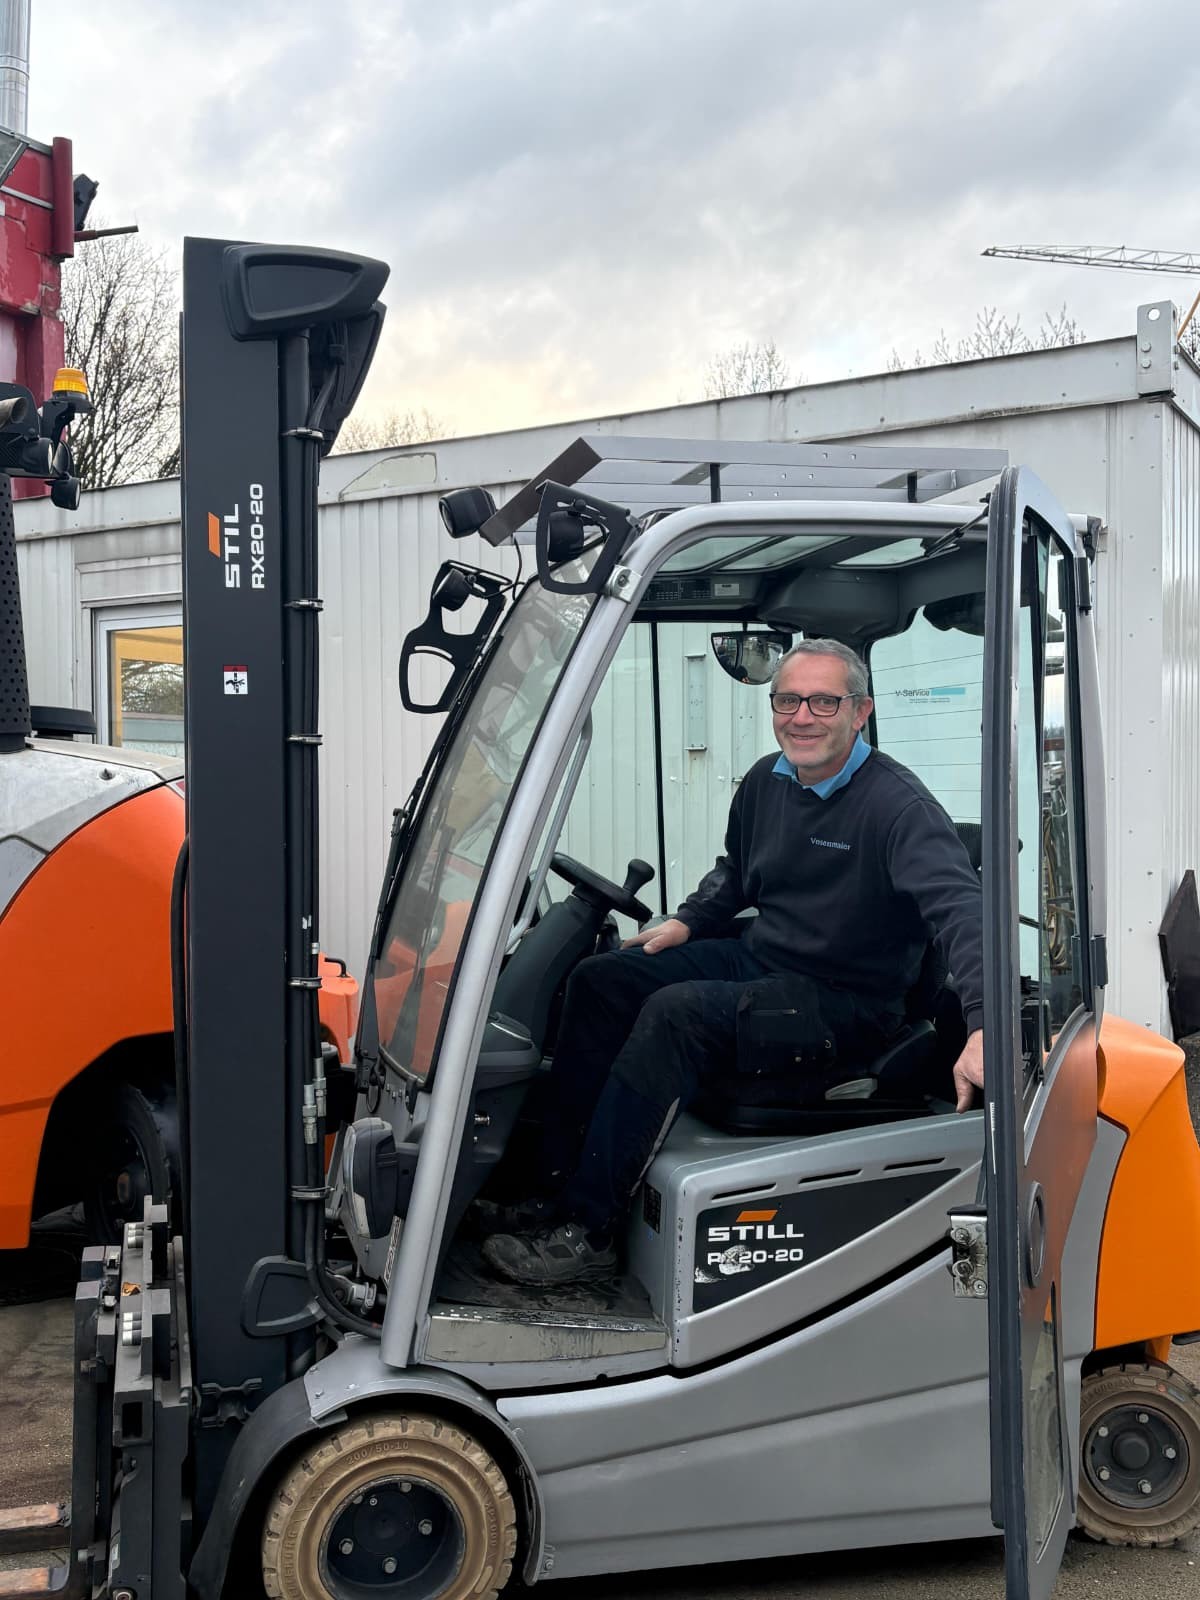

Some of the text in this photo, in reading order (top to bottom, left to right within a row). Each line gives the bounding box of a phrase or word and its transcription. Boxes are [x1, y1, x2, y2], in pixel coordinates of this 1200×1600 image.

[223, 503, 240, 588] STIL
[249, 483, 265, 589] RX20-20
[708, 1224, 805, 1242] STILL
